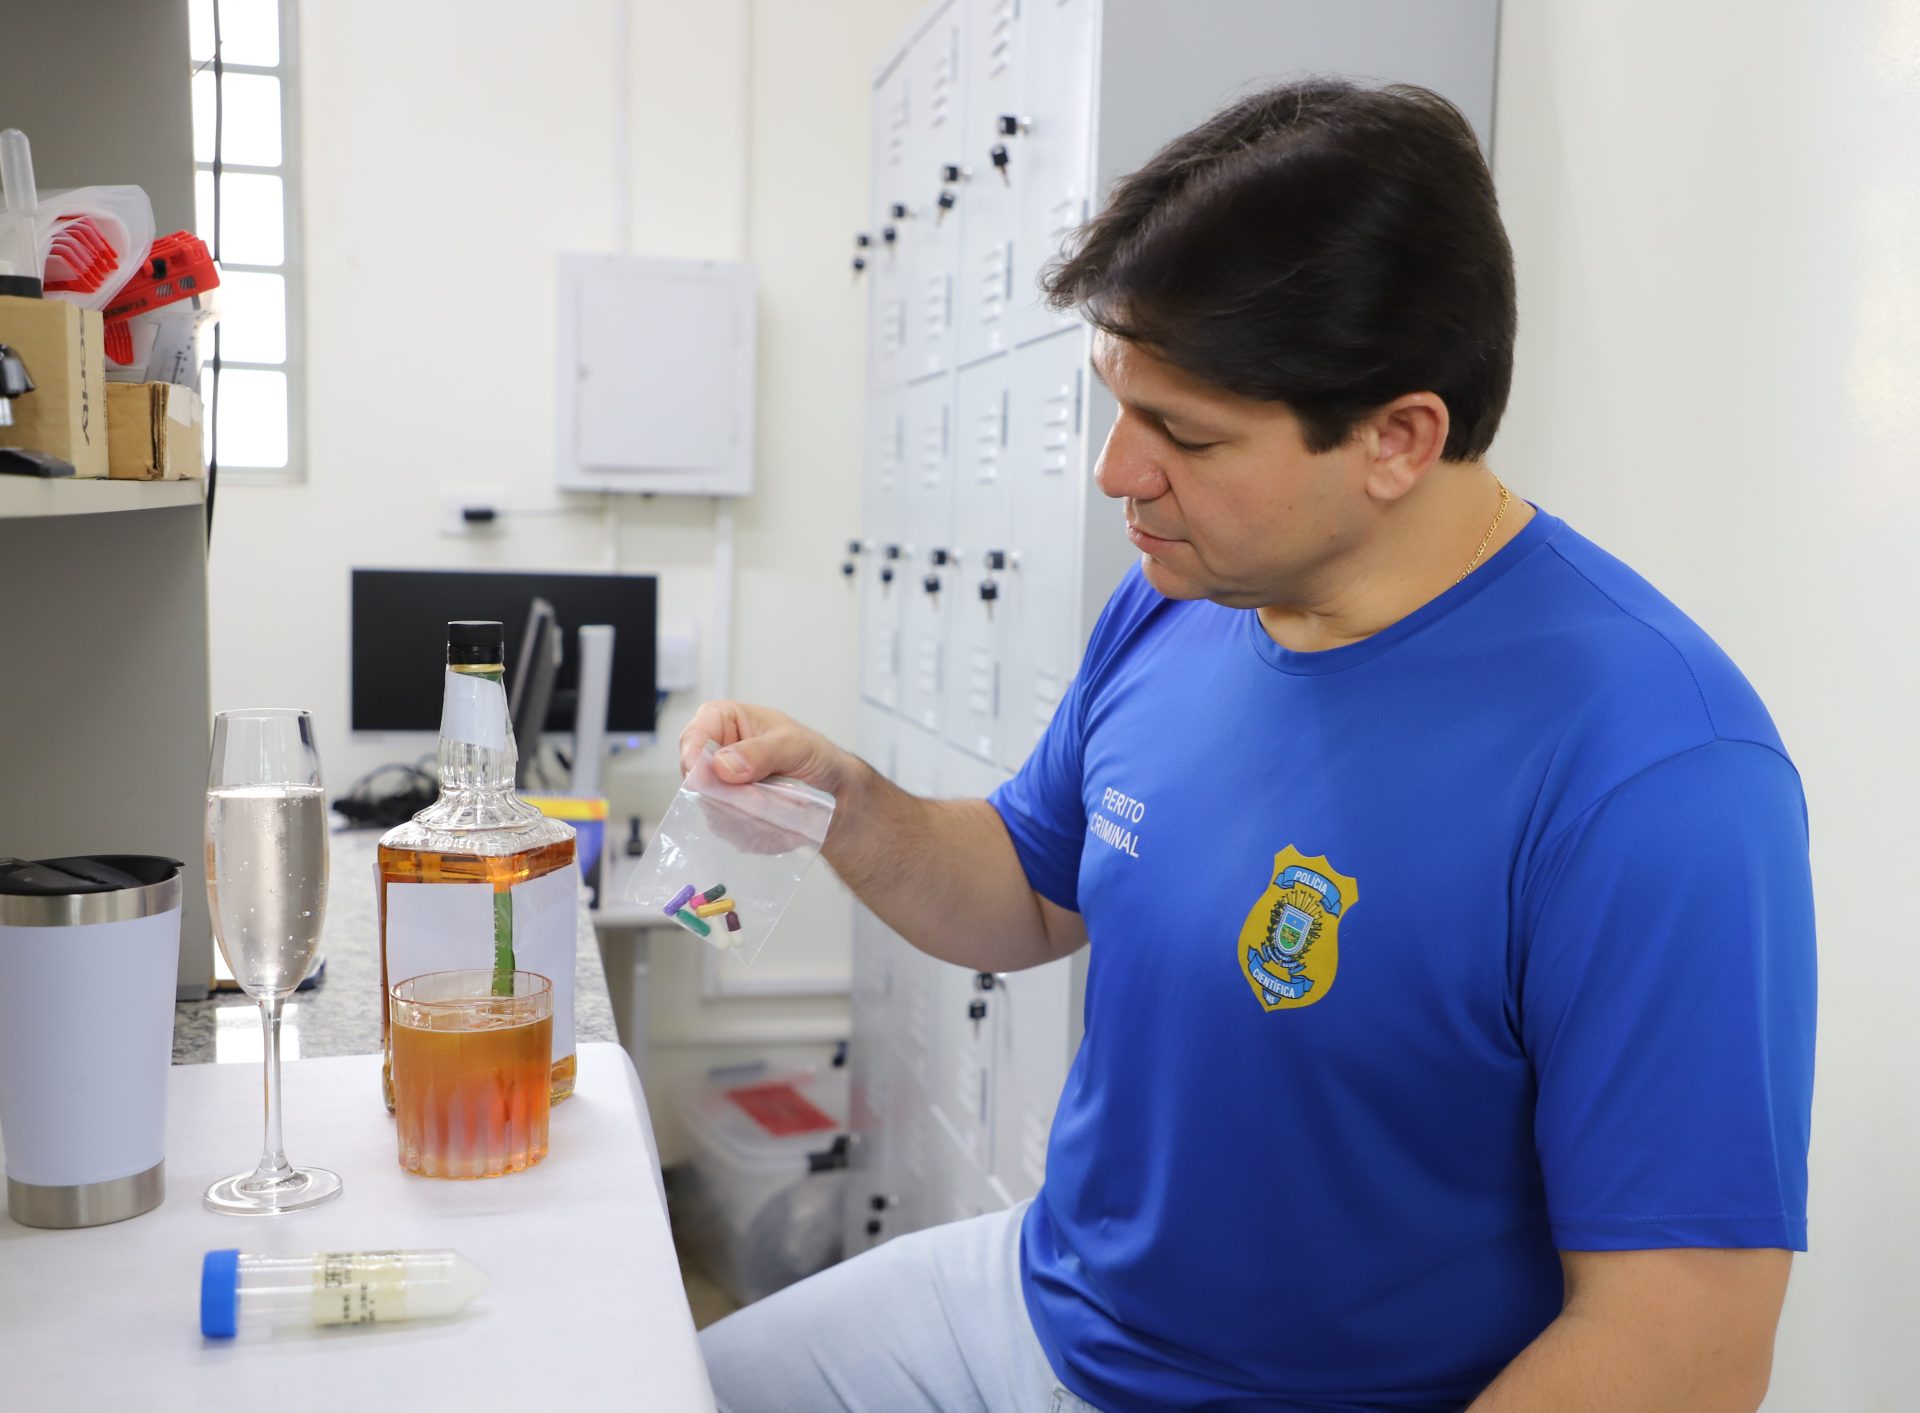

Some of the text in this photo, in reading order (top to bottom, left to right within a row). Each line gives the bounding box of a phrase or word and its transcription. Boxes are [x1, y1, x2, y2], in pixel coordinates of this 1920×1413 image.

[1101, 786, 1145, 824] PERITO
[1090, 812, 1139, 858] CRIMINAL
[1293, 870, 1329, 895] POLÍCIA
[1252, 968, 1296, 998] CIENTÍFICA
